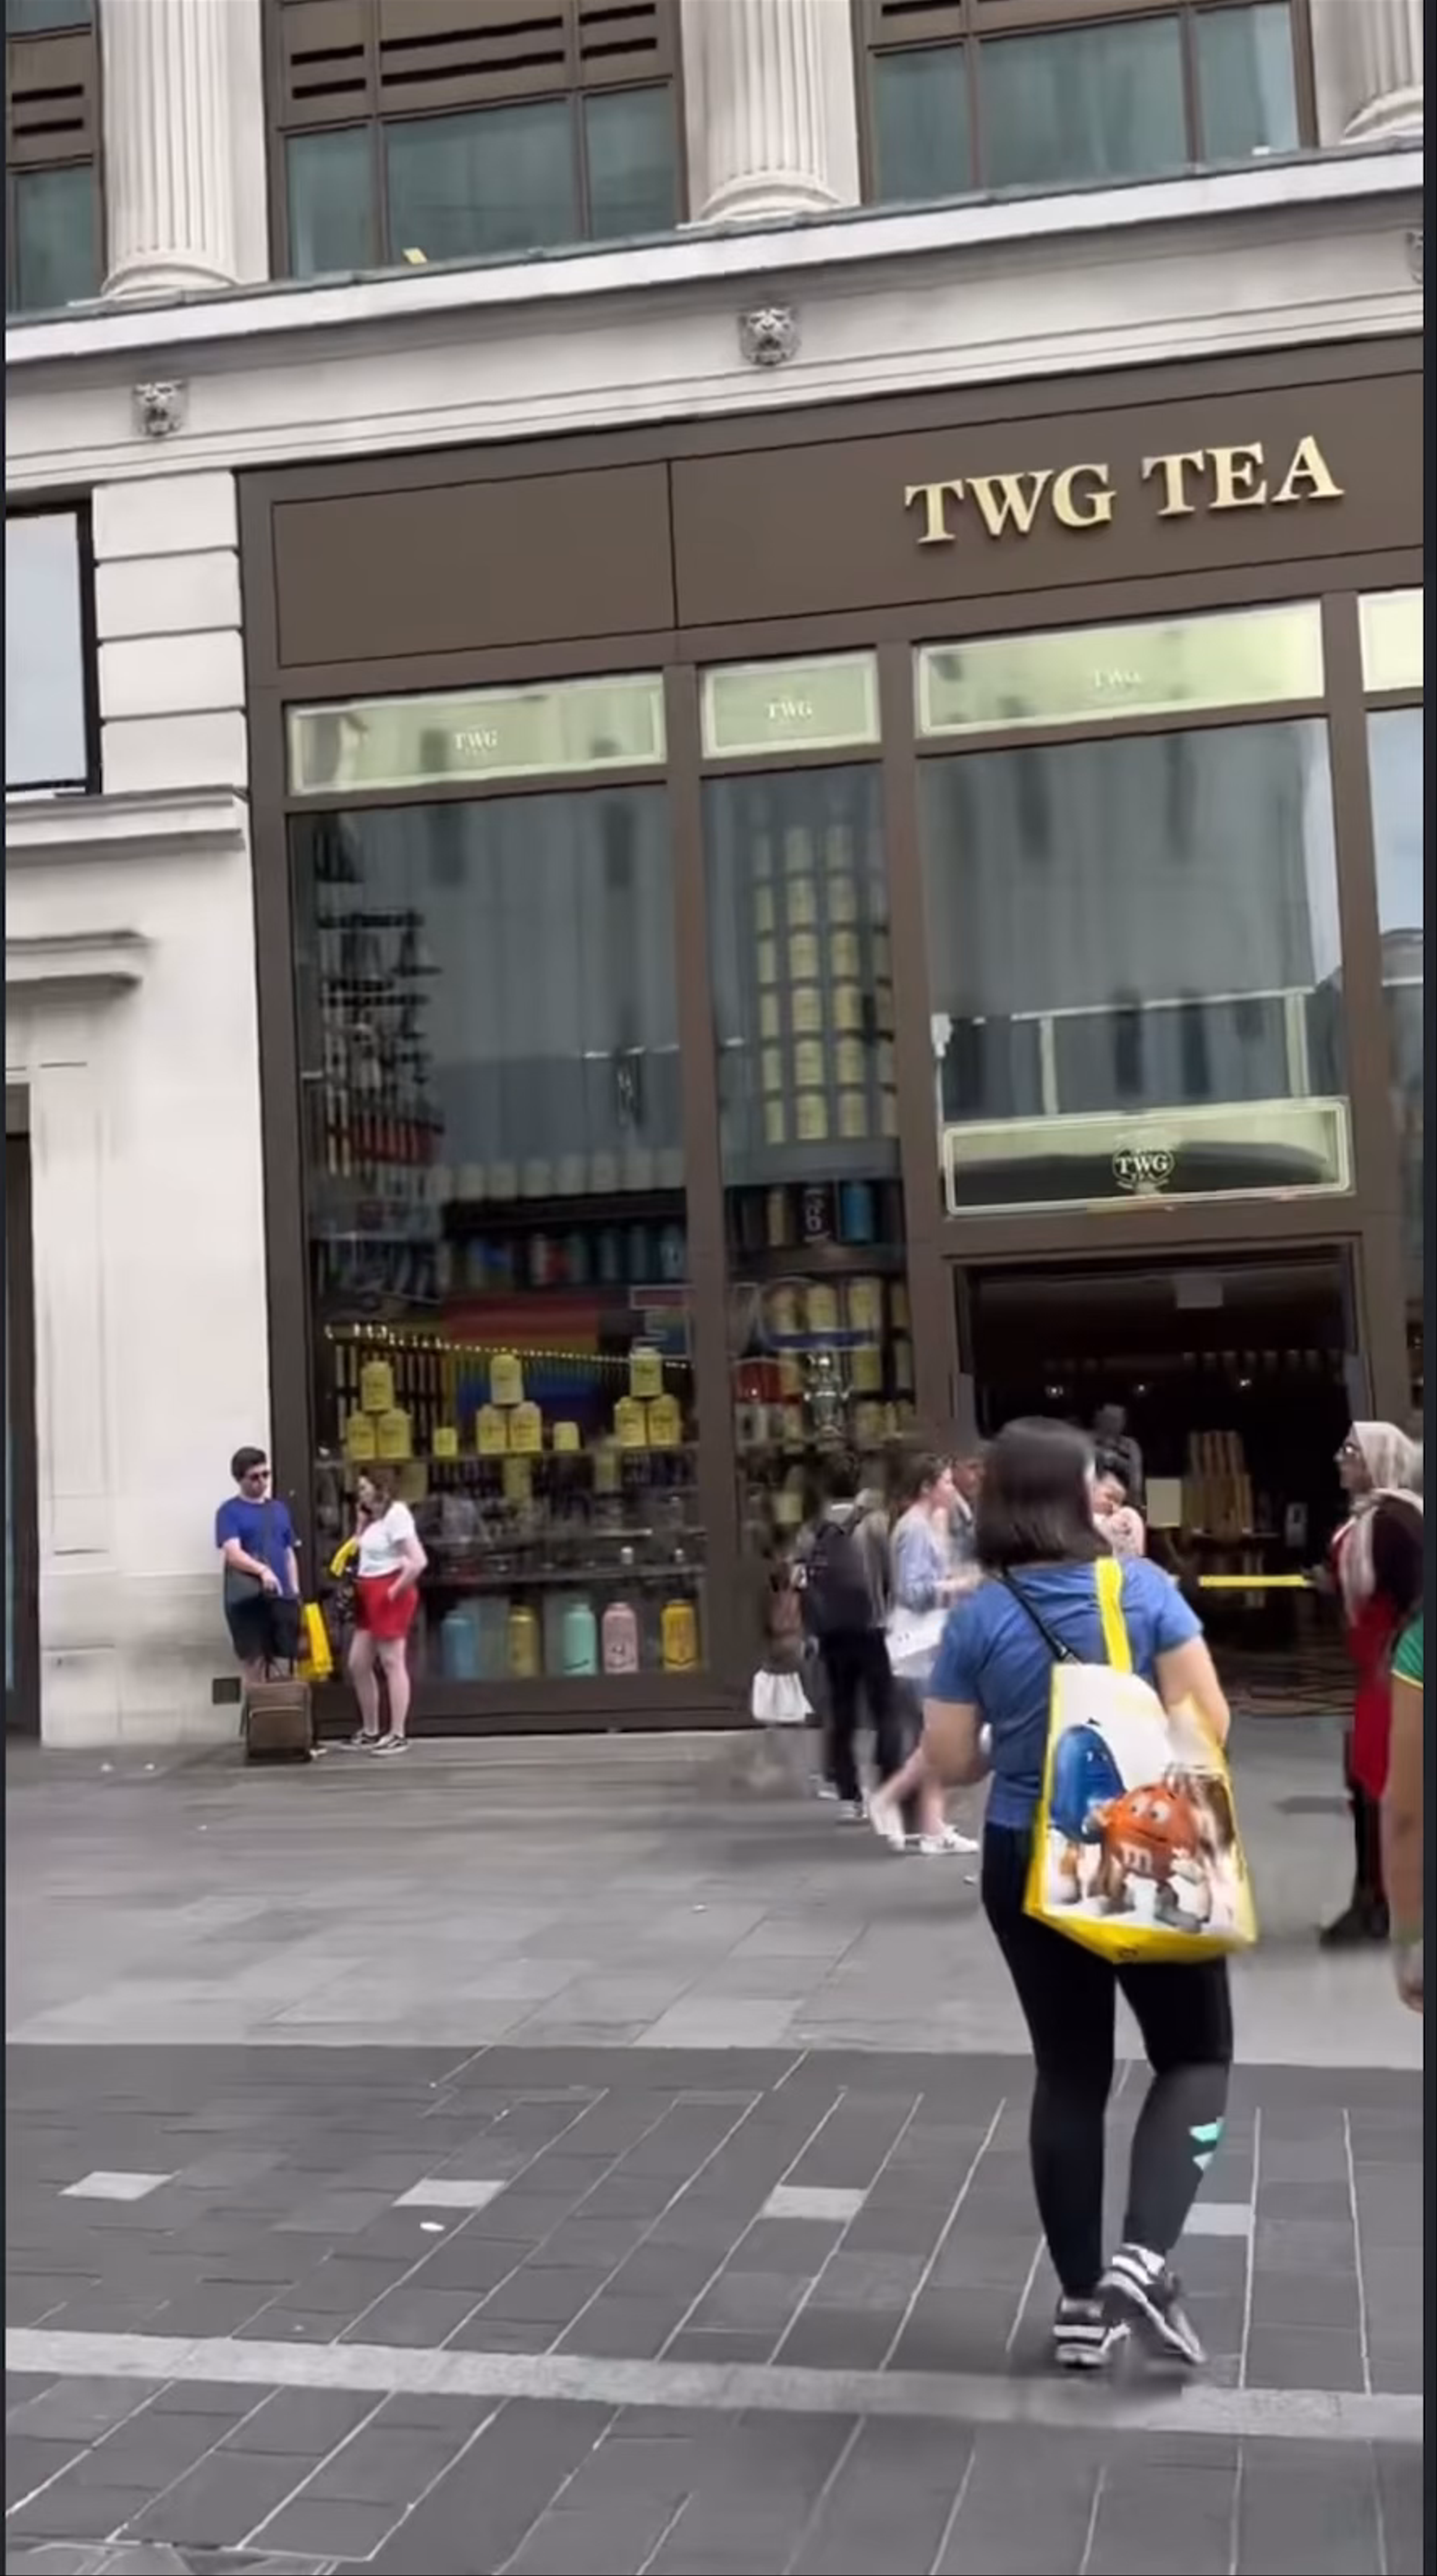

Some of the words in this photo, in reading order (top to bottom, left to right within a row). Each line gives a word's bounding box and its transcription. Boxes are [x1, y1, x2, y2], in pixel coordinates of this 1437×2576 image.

[904, 463, 1116, 544] TWG
[1142, 435, 1344, 516] TEA
[455, 730, 498, 750] TWG
[1115, 1153, 1167, 1174] TWG
